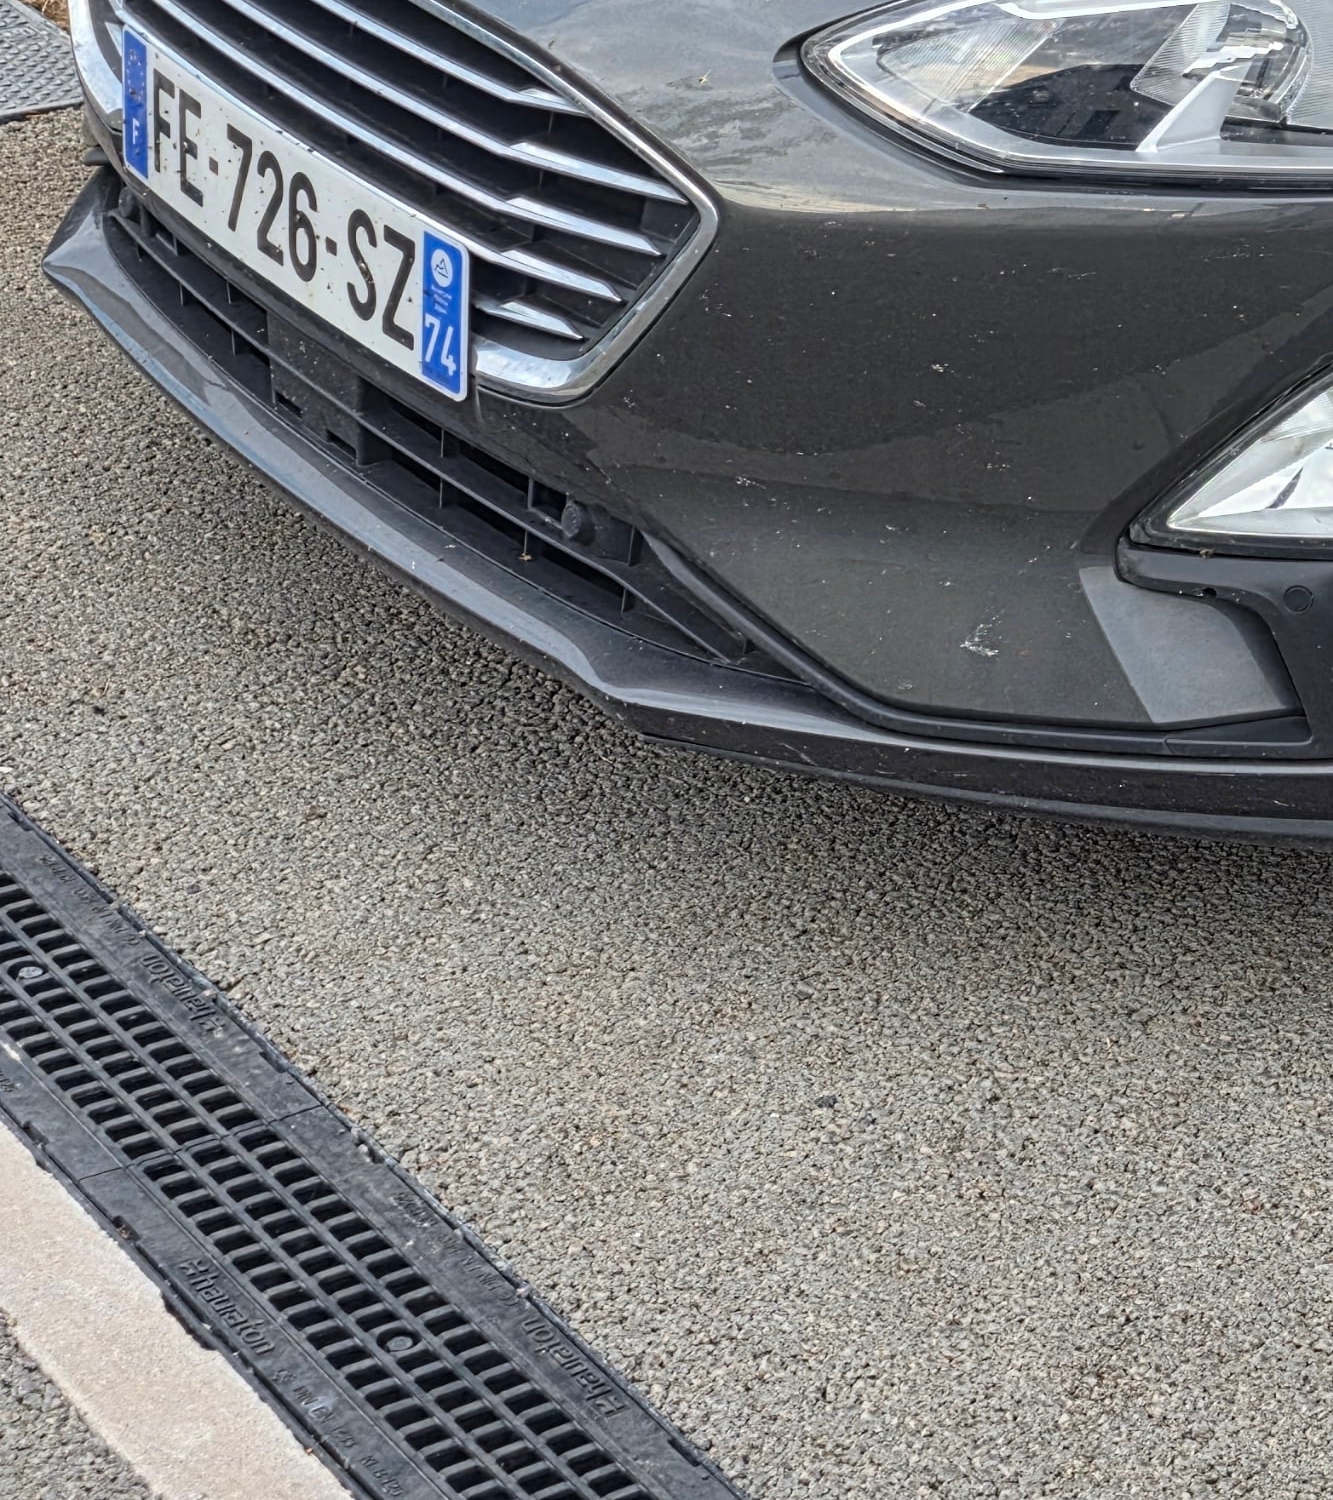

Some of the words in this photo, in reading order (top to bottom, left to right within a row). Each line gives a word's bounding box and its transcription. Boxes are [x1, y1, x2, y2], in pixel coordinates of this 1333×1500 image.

[132, 117, 141, 145] F
[153, 68, 415, 351] FE-726-SZ
[425, 313, 457, 376] 74
[189, 1270, 275, 1356] hauraton
[522, 1318, 613, 1404] hauraton
